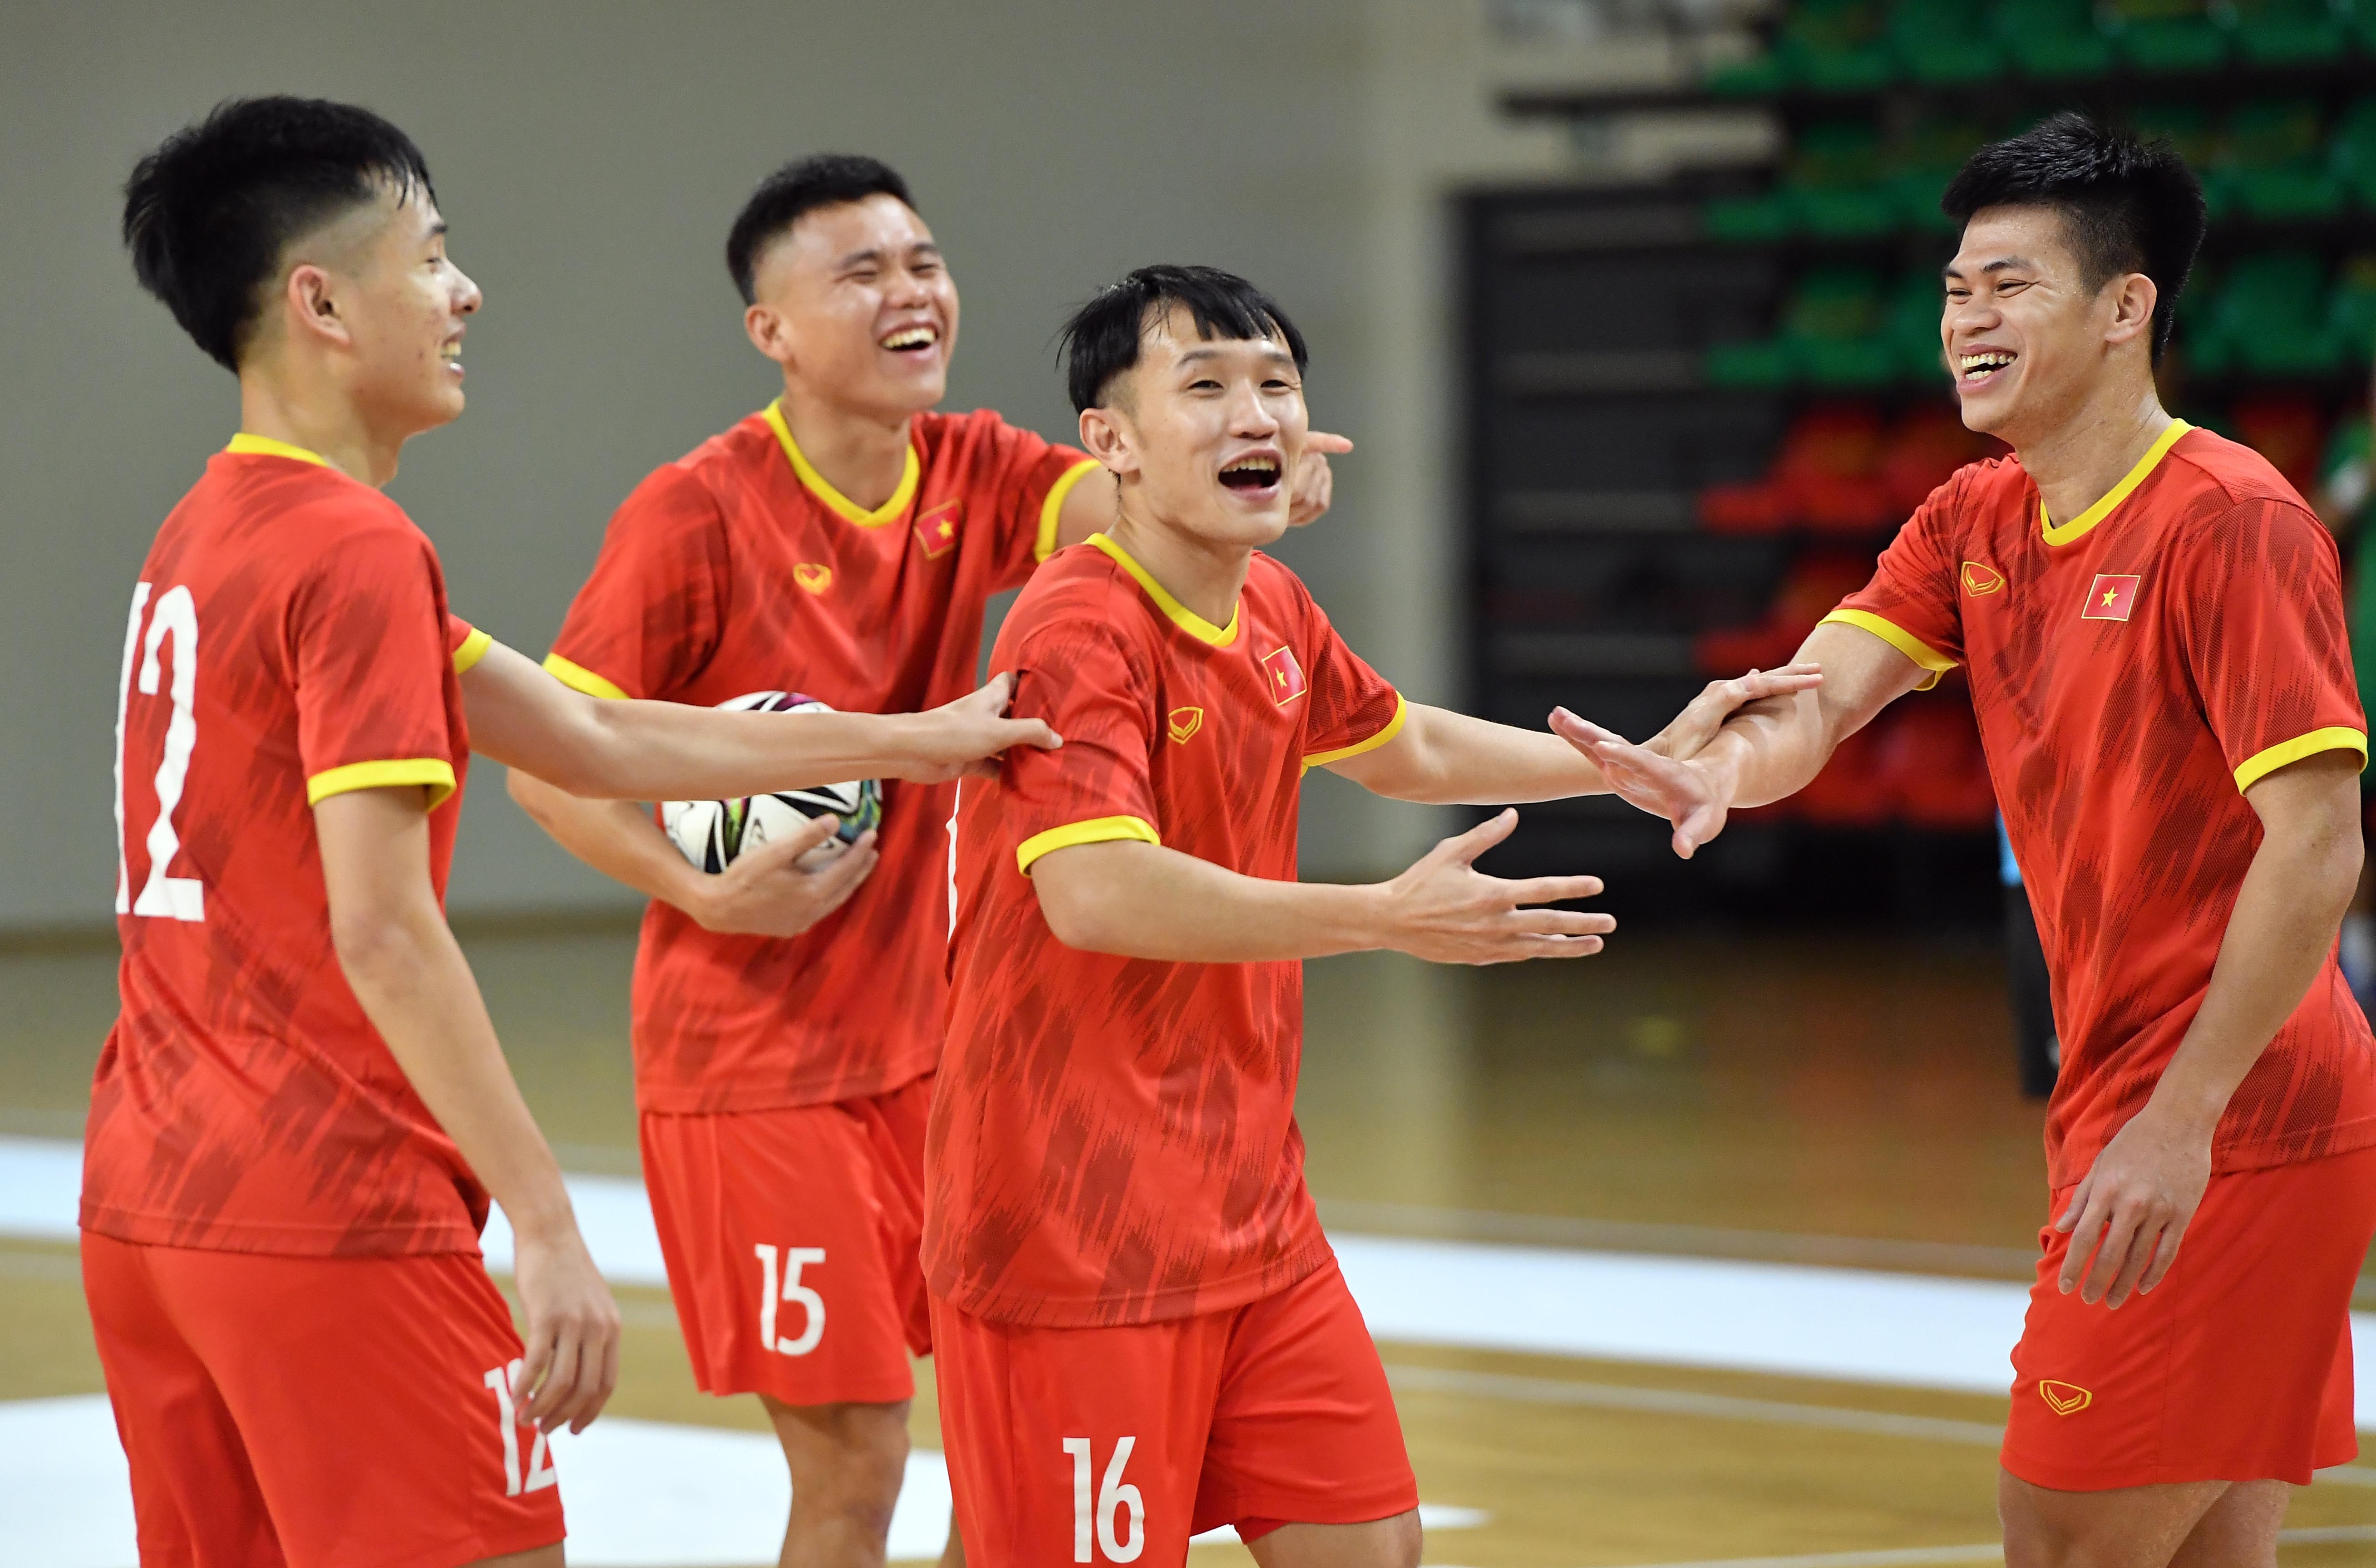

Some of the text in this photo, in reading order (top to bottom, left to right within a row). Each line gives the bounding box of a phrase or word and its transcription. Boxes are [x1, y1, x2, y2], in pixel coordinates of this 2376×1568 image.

[114, 582, 205, 922] 12
[754, 1242, 826, 1356] 15
[1063, 1436, 1145, 1563] 16
